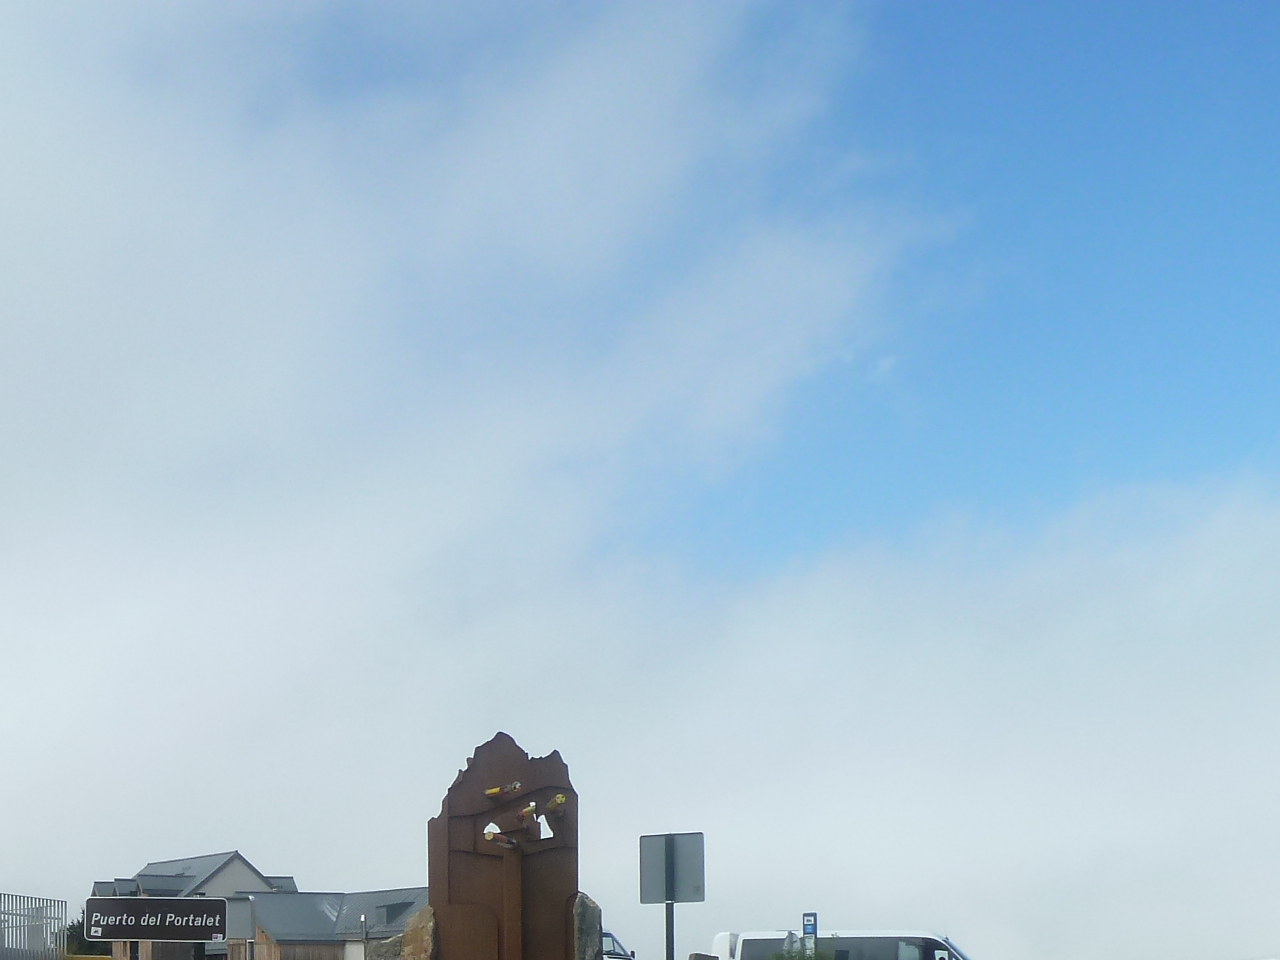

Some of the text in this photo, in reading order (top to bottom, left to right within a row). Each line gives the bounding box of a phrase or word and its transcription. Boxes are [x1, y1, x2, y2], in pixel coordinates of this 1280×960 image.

[91, 912, 221, 926] Puerto del Portalet
